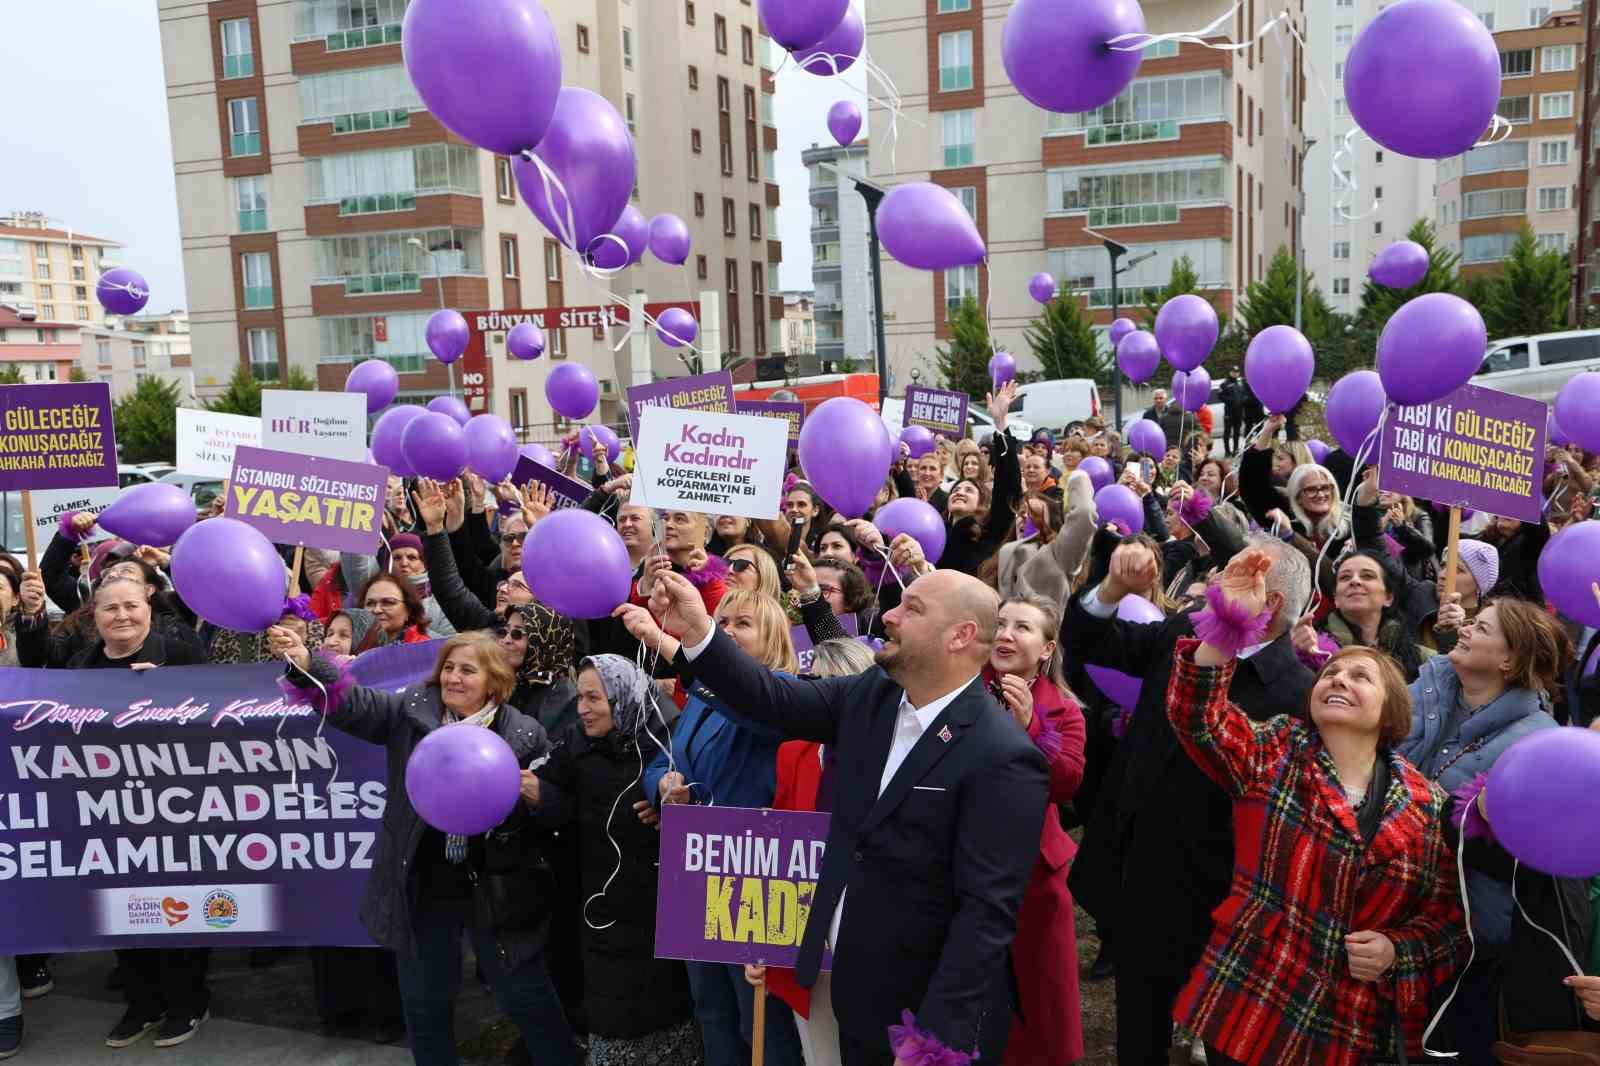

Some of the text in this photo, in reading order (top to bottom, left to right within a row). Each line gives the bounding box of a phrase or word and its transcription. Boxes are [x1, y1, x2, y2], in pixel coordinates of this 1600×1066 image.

[477, 307, 617, 331] BÜNYAN SİTESİ
[463, 373, 484, 385] NO
[672, 385, 728, 407] GÜLECEĞİZ
[913, 391, 928, 403] BEN
[5, 404, 101, 431] GÜLECEĞİZ
[912, 402, 933, 420] BEN
[272, 416, 311, 434] HÜR
[681, 423, 745, 449] Kadın
[1435, 404, 1452, 433] Kİ
[1455, 409, 1536, 452] GÜLECEĞİZ
[0, 429, 104, 455] KONUŞACAĞIZ
[1394, 426, 1534, 477] TABİ Kİ KONUŞACAĞIZ
[0, 451, 105, 470] AHKAHA ATACAĞIZ
[663, 443, 759, 470] Kadındır
[235, 464, 379, 503] İSTANBUL SÖZLEŞMESİ
[657, 478, 756, 496] KOPARMAYIN Bİ
[665, 467, 751, 485] ÇİÇEKLERİ DE
[1392, 451, 1532, 498] TABİ Kİ KAHKAHA ATACAĞIZ
[52, 498, 92, 514] ÖLMEK
[233, 485, 376, 532] YAŞATIR
[677, 490, 733, 505] ZAHMET.
[11, 736, 333, 779] KADINLARIN
[0, 780, 388, 830] LI MÜCADELES
[0, 831, 376, 881] SELAMLIYORUZ
[684, 829, 826, 880] BENİM AD
[128, 902, 161, 911] KADIN
[704, 875, 819, 947] KADI
